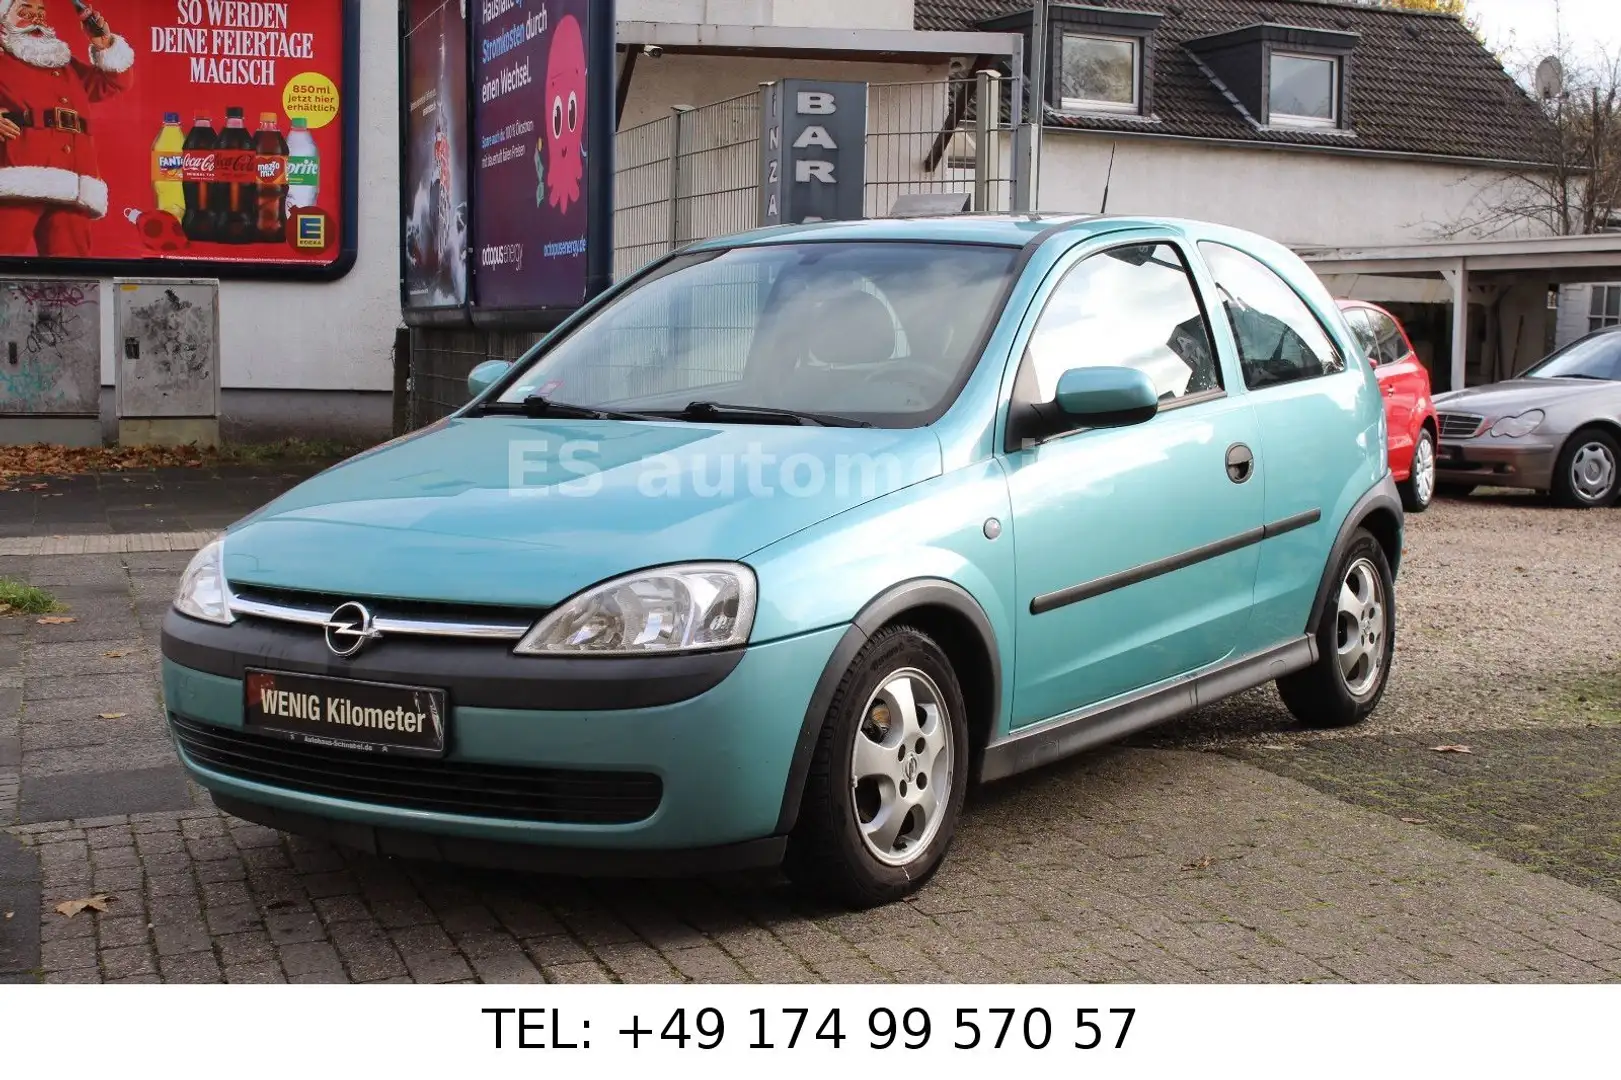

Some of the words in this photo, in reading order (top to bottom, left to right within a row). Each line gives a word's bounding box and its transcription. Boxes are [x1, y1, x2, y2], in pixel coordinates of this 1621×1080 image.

[177, 0, 204, 25] SO
[207, 1, 288, 29] WERDEN
[151, 27, 208, 54] DEINE
[212, 30, 314, 59] FEIERTAGE
[482, 23, 525, 64] Stromkosten
[526, 2, 548, 41] durch
[190, 57, 275, 86] MAGISCH
[482, 72, 500, 104] einen
[500, 56, 532, 95] Wechsel.
[287, 103, 336, 112] erhältlich
[288, 94, 312, 103] jetzt
[315, 95, 335, 103] hier
[792, 91, 838, 184] BAR
[159, 156, 184, 167] FANT
[183, 153, 215, 171] Coca-Co
[257, 161, 280, 172] mezzo
[286, 159, 318, 175] prite
[260, 169, 275, 178] mix
[260, 687, 320, 721] WENIG
[327, 696, 426, 733] Kilometer
